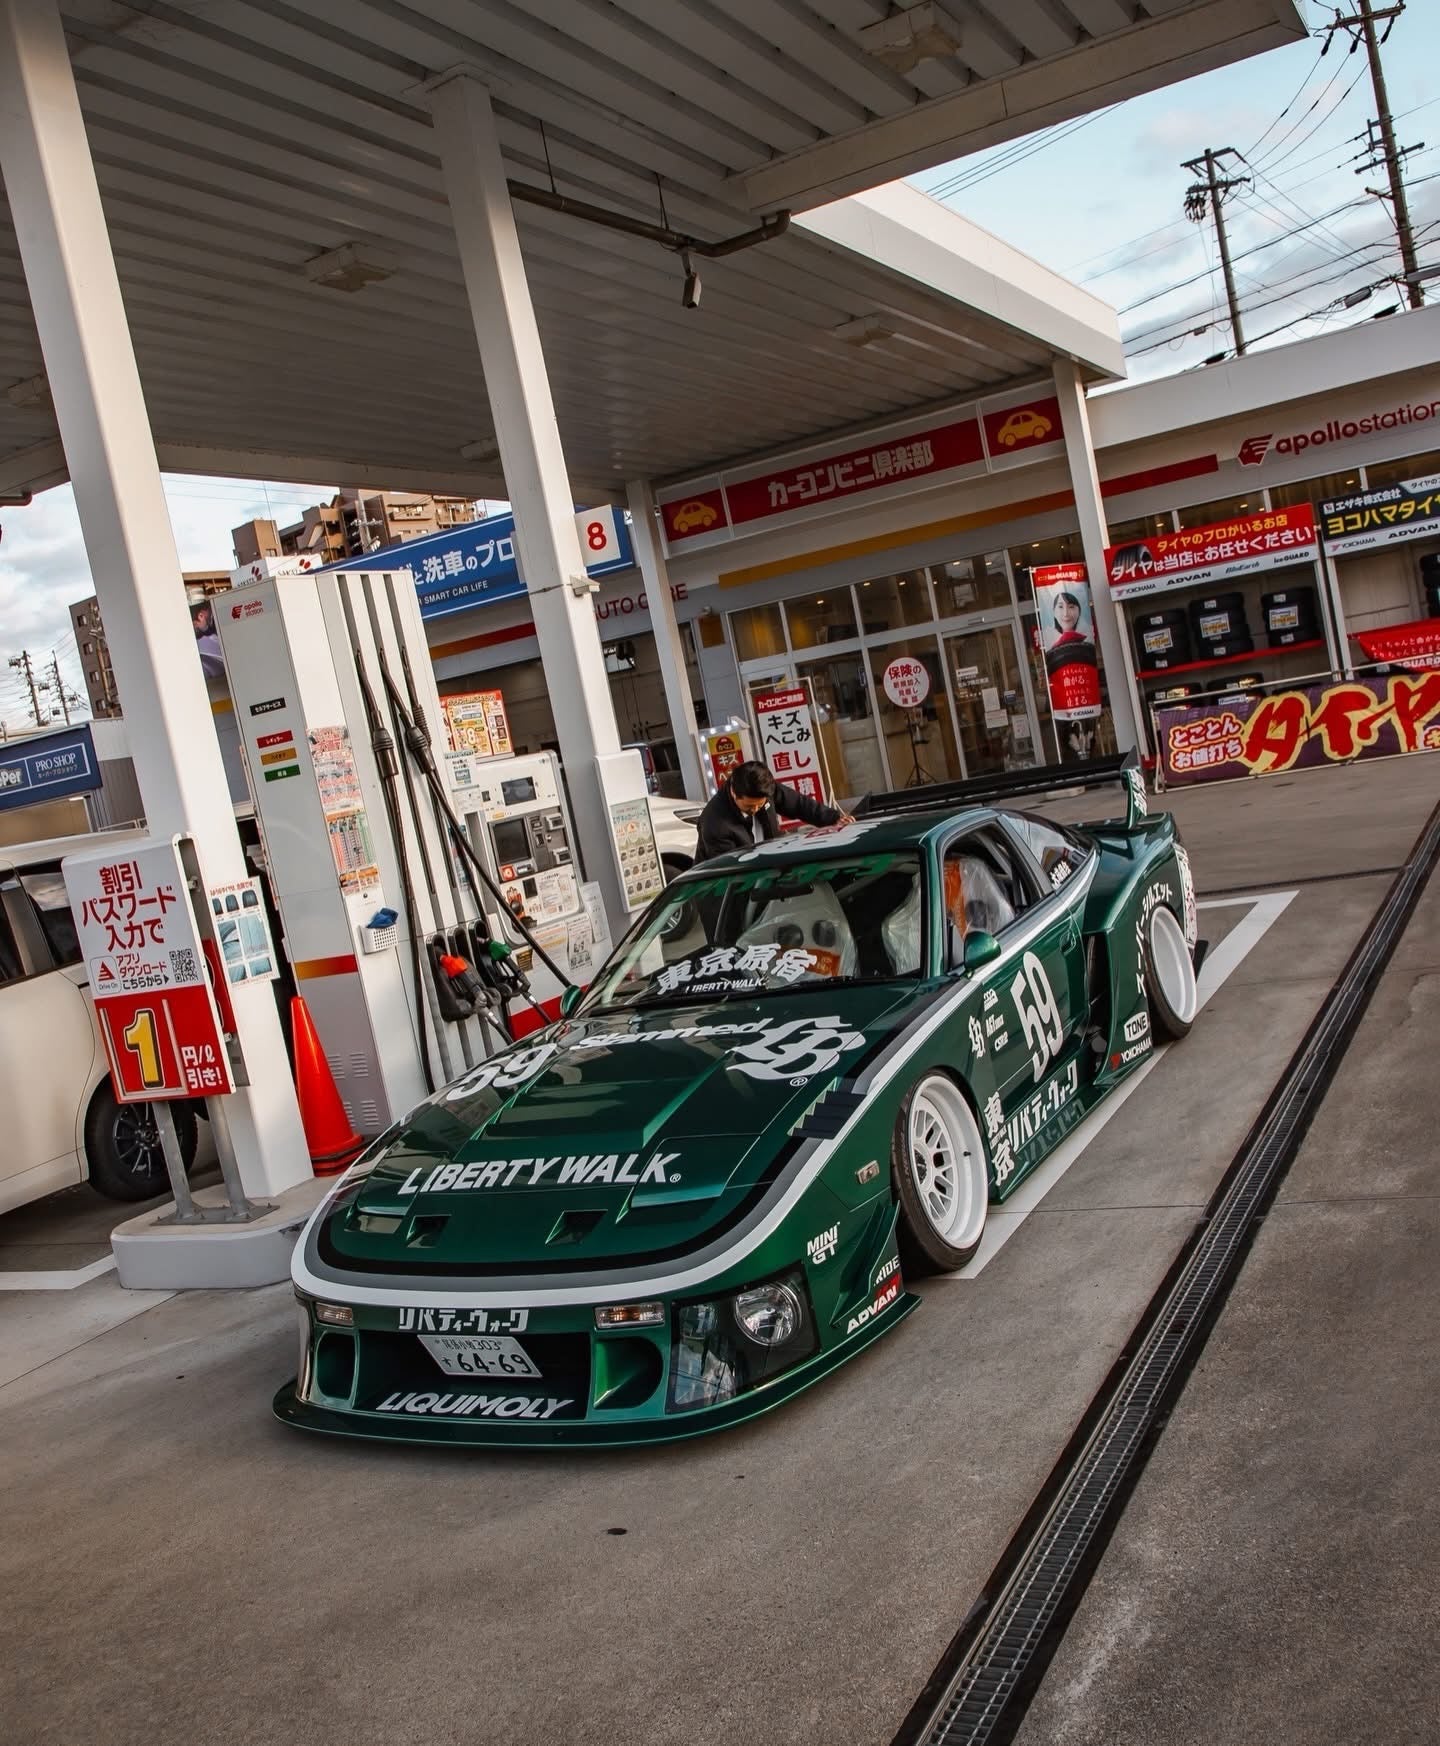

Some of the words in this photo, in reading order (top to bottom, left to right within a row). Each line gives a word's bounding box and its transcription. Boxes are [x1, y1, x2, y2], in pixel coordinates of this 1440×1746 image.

[768, 440, 935, 507] カーコンビニ倶楽部
[587, 522, 607, 550] 8
[1157, 515, 1288, 552] タイヤのプロがいるお店
[1388, 524, 1439, 539] ADVAN
[1111, 527, 1312, 581] タイヤは当店にお任せください
[1166, 571, 1211, 586] ADVAN
[424, 592, 450, 606] SMART
[452, 587, 469, 598] CAR
[470, 580, 489, 593] LIFE
[595, 597, 634, 620] UTO
[888, 663, 922, 680] 保険の
[768, 710, 801, 729] キズ
[1173, 716, 1240, 747] とことん
[766, 727, 811, 745] へこみ
[35, 758, 53, 772] PRO
[53, 753, 76, 768] SHOP
[718, 753, 739, 767] キズ
[772, 750, 811, 772] 直し
[1174, 742, 1242, 767] お値打ち
[99, 861, 143, 894] 割引
[81, 885, 177, 927] パスワード
[107, 918, 165, 952] 入力で
[116, 953, 140, 965] アプリ
[119, 961, 167, 977] ダウンロード
[122, 975, 163, 990] こちらから
[1011, 951, 1064, 1083] 59
[1126, 1015, 1147, 1037] TONE
[124, 1008, 166, 1089] 1
[1120, 1040, 1152, 1064] YOKOHAMA
[447, 1043, 557, 1100] 59
[1007, 1059, 1078, 1153] リバティーウォーク
[398, 1157, 561, 1195] LIBERTY
[557, 1153, 681, 1184] WALK
[807, 1225, 838, 1257] MINI
[812, 1239, 838, 1265] GT
[398, 1308, 530, 1333] リバティーウォーク
[846, 1285, 898, 1335] ADVAN
[456, 1353, 533, 1374] 64-69
